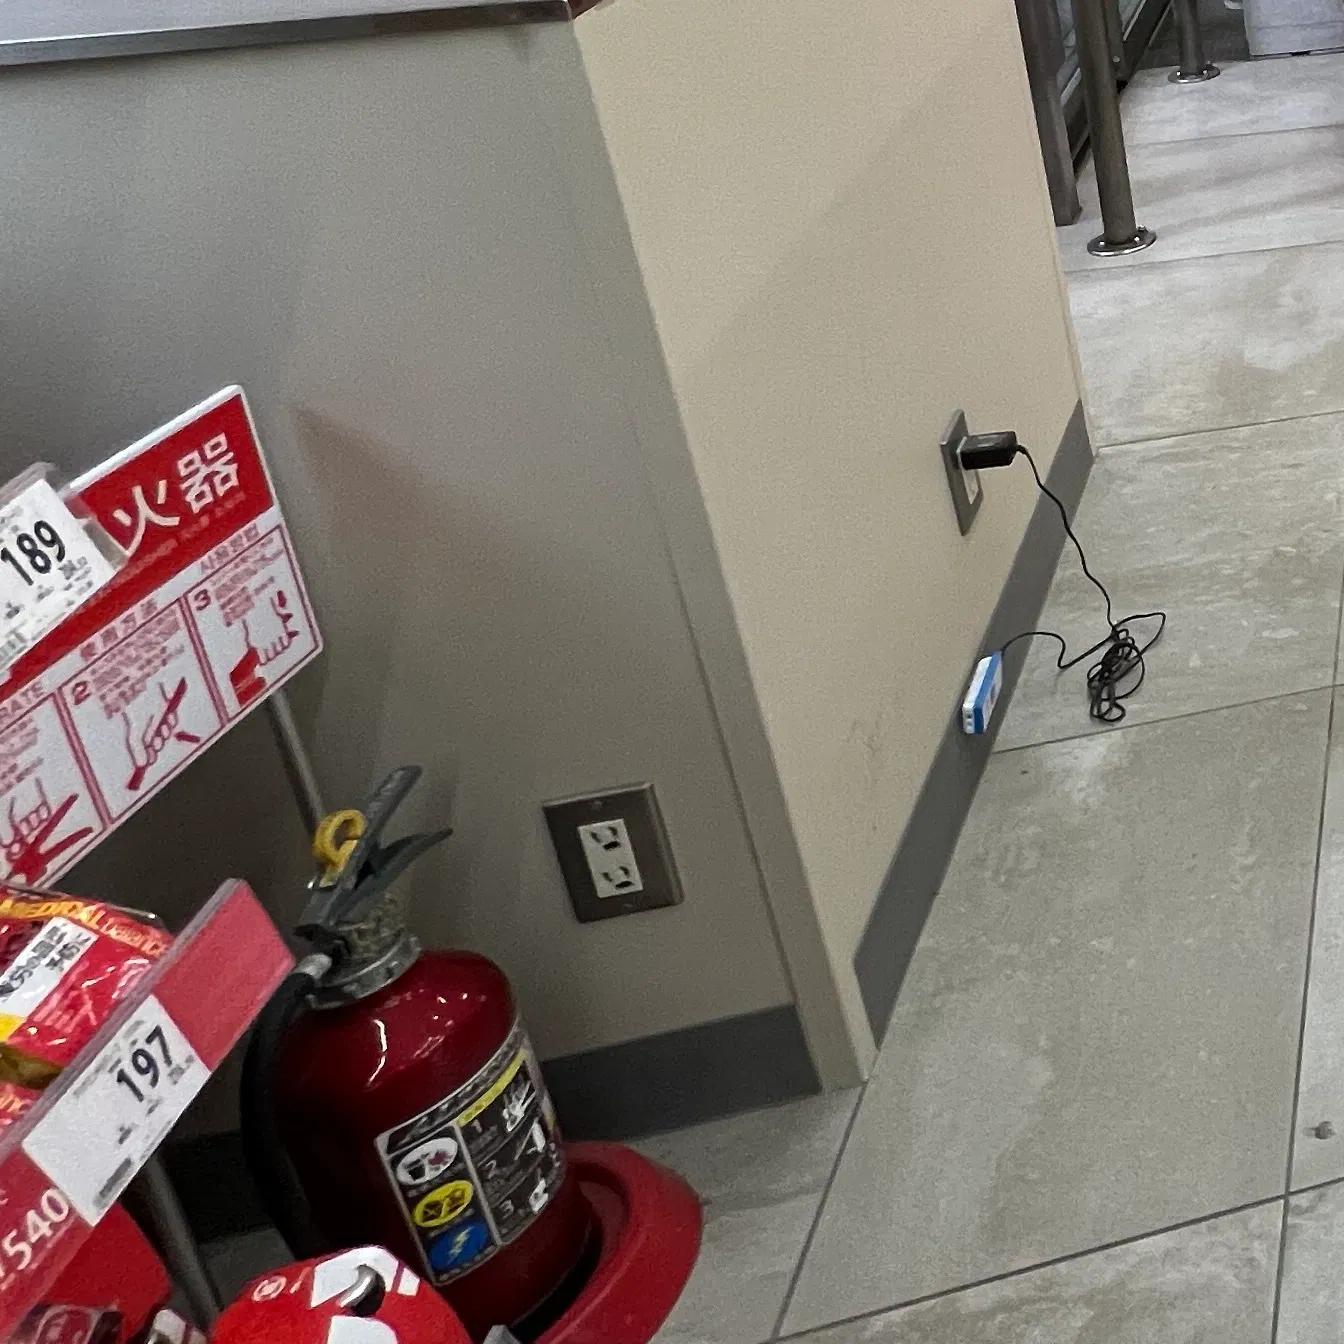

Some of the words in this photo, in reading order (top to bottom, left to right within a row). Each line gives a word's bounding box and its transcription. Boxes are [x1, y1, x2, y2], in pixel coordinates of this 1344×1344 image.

[0, 520, 66, 586] 189
[194, 588, 212, 611] 3
[71, 684, 91, 706] 2
[116, 1025, 173, 1103] 197
